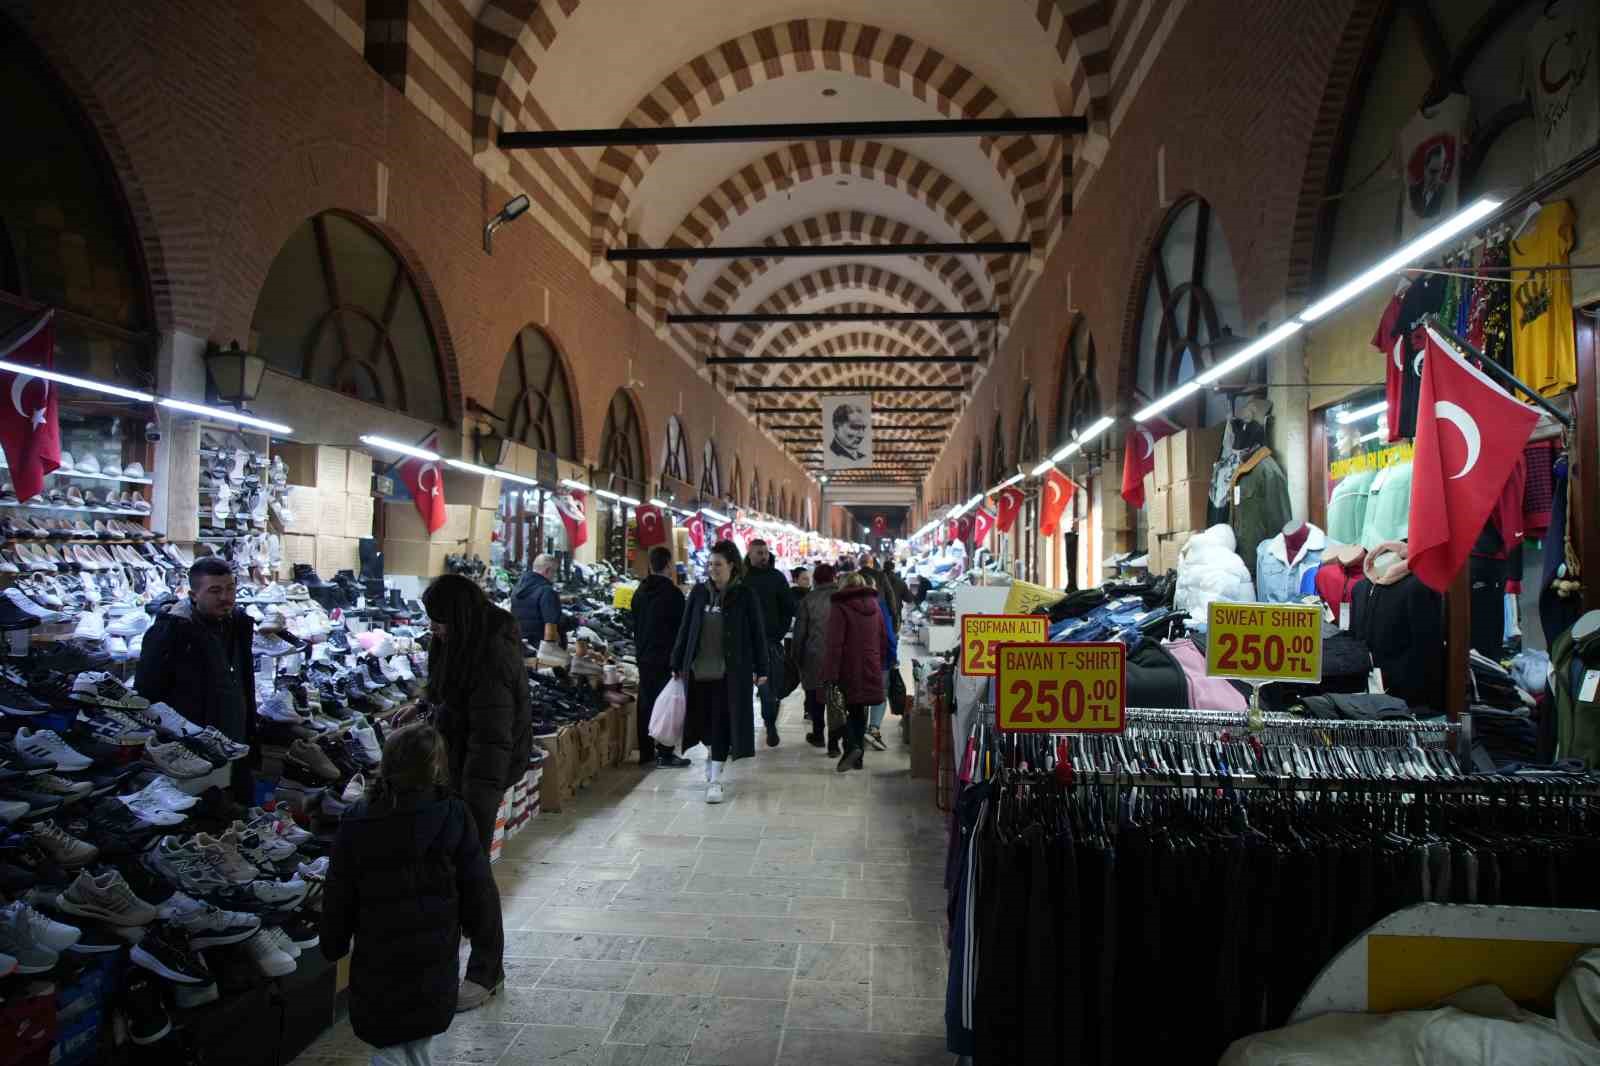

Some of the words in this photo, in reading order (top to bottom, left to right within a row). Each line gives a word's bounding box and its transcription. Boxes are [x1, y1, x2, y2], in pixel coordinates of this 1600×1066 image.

[1216, 608, 1266, 626] SWEAT
[1271, 610, 1316, 627] SHIRT
[966, 620, 1015, 636] EŞOFMAN
[1019, 620, 1041, 633] ALTI
[1007, 652, 1053, 670] BAYAN
[1058, 652, 1119, 670] T-SHIRT
[1287, 657, 1312, 672] TL
[1088, 705, 1115, 722] TL
